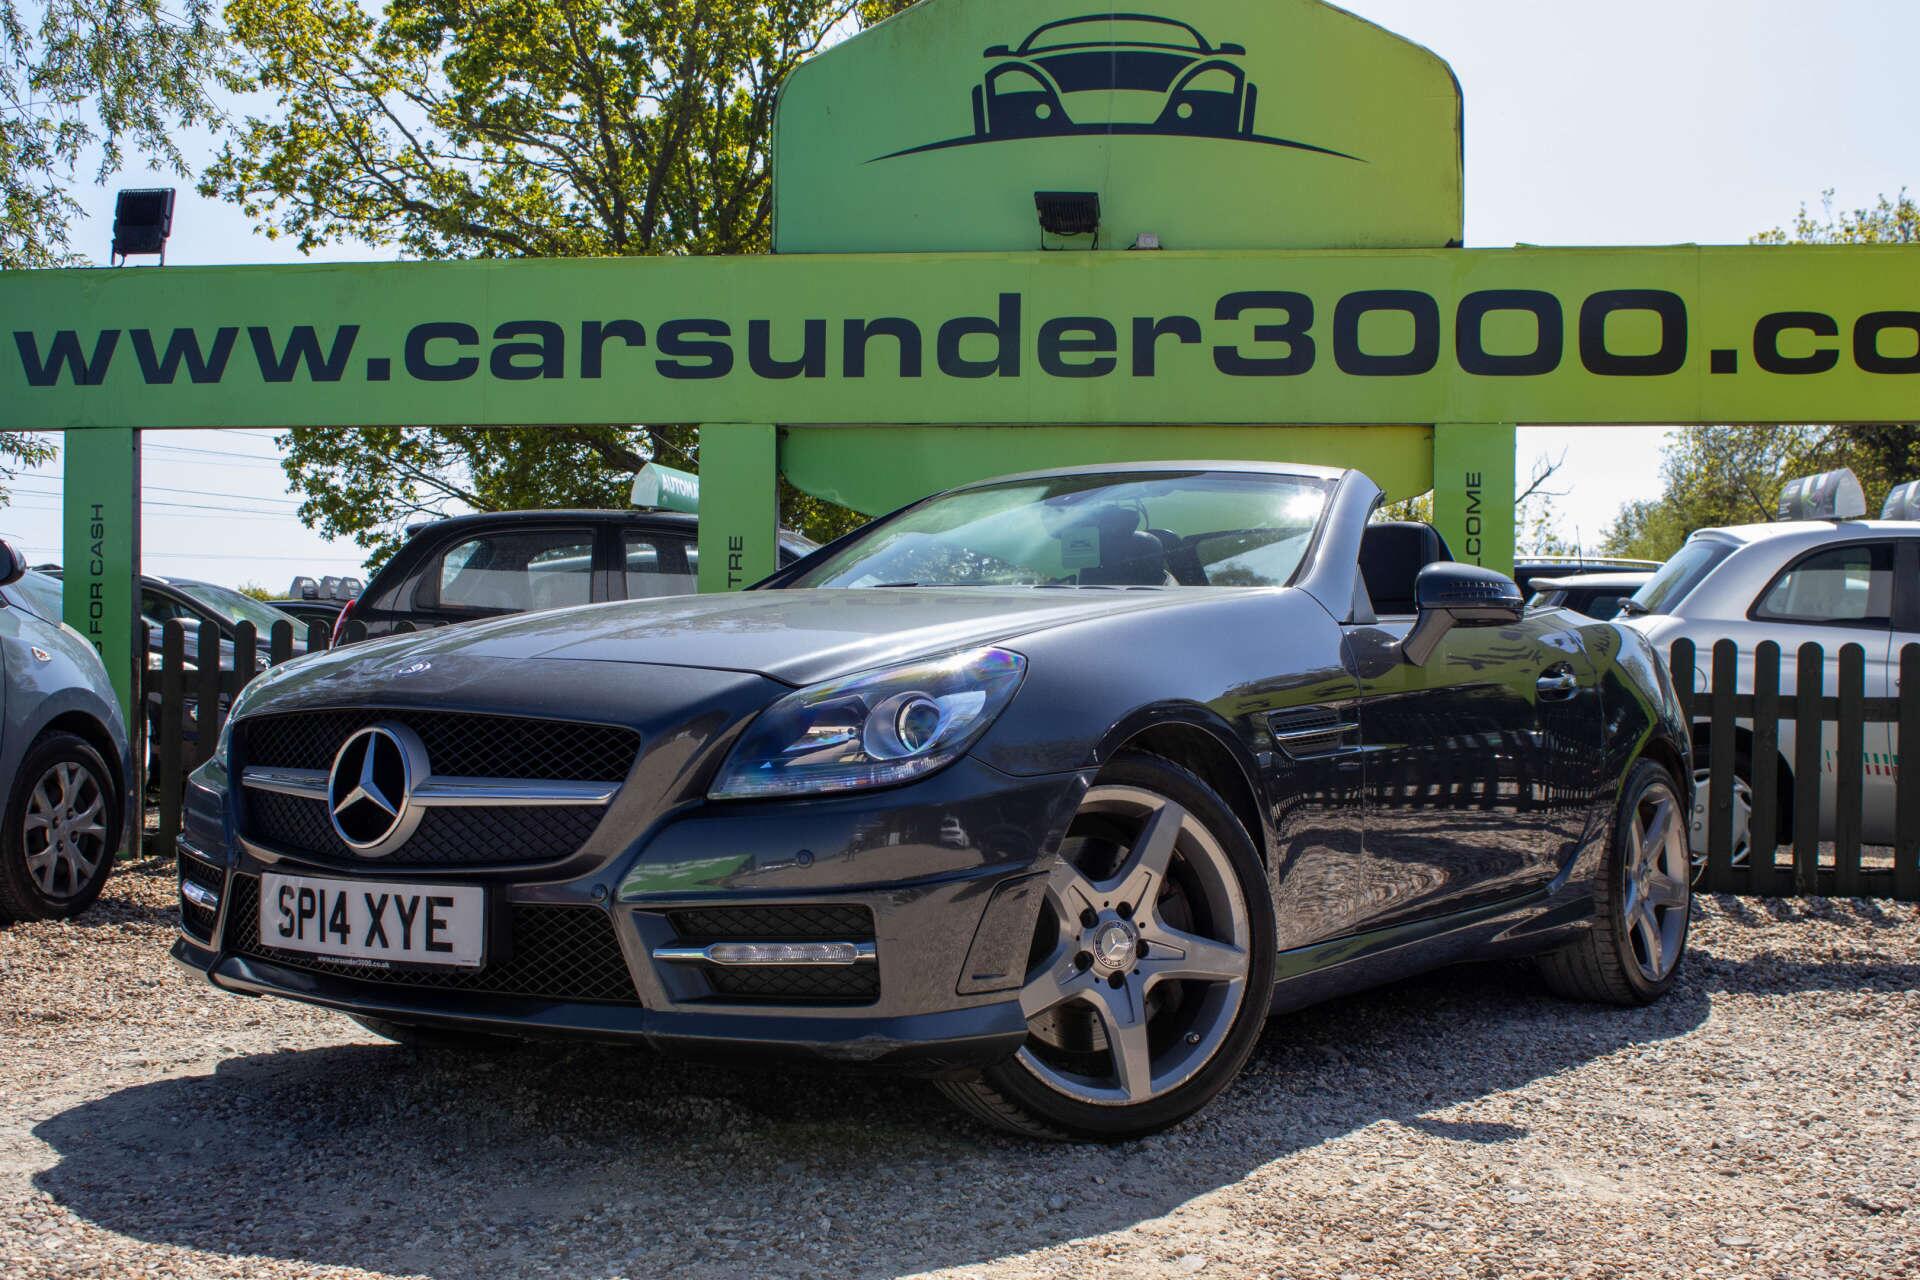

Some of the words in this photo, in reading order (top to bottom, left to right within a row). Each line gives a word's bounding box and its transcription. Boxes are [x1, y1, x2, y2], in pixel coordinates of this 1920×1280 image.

[12, 289, 1920, 387] www.carsunder3000.co
[90, 504, 104, 576] CASH
[90, 583, 103, 634] FOR
[278, 885, 351, 945] SP14
[364, 893, 454, 952] XYE
